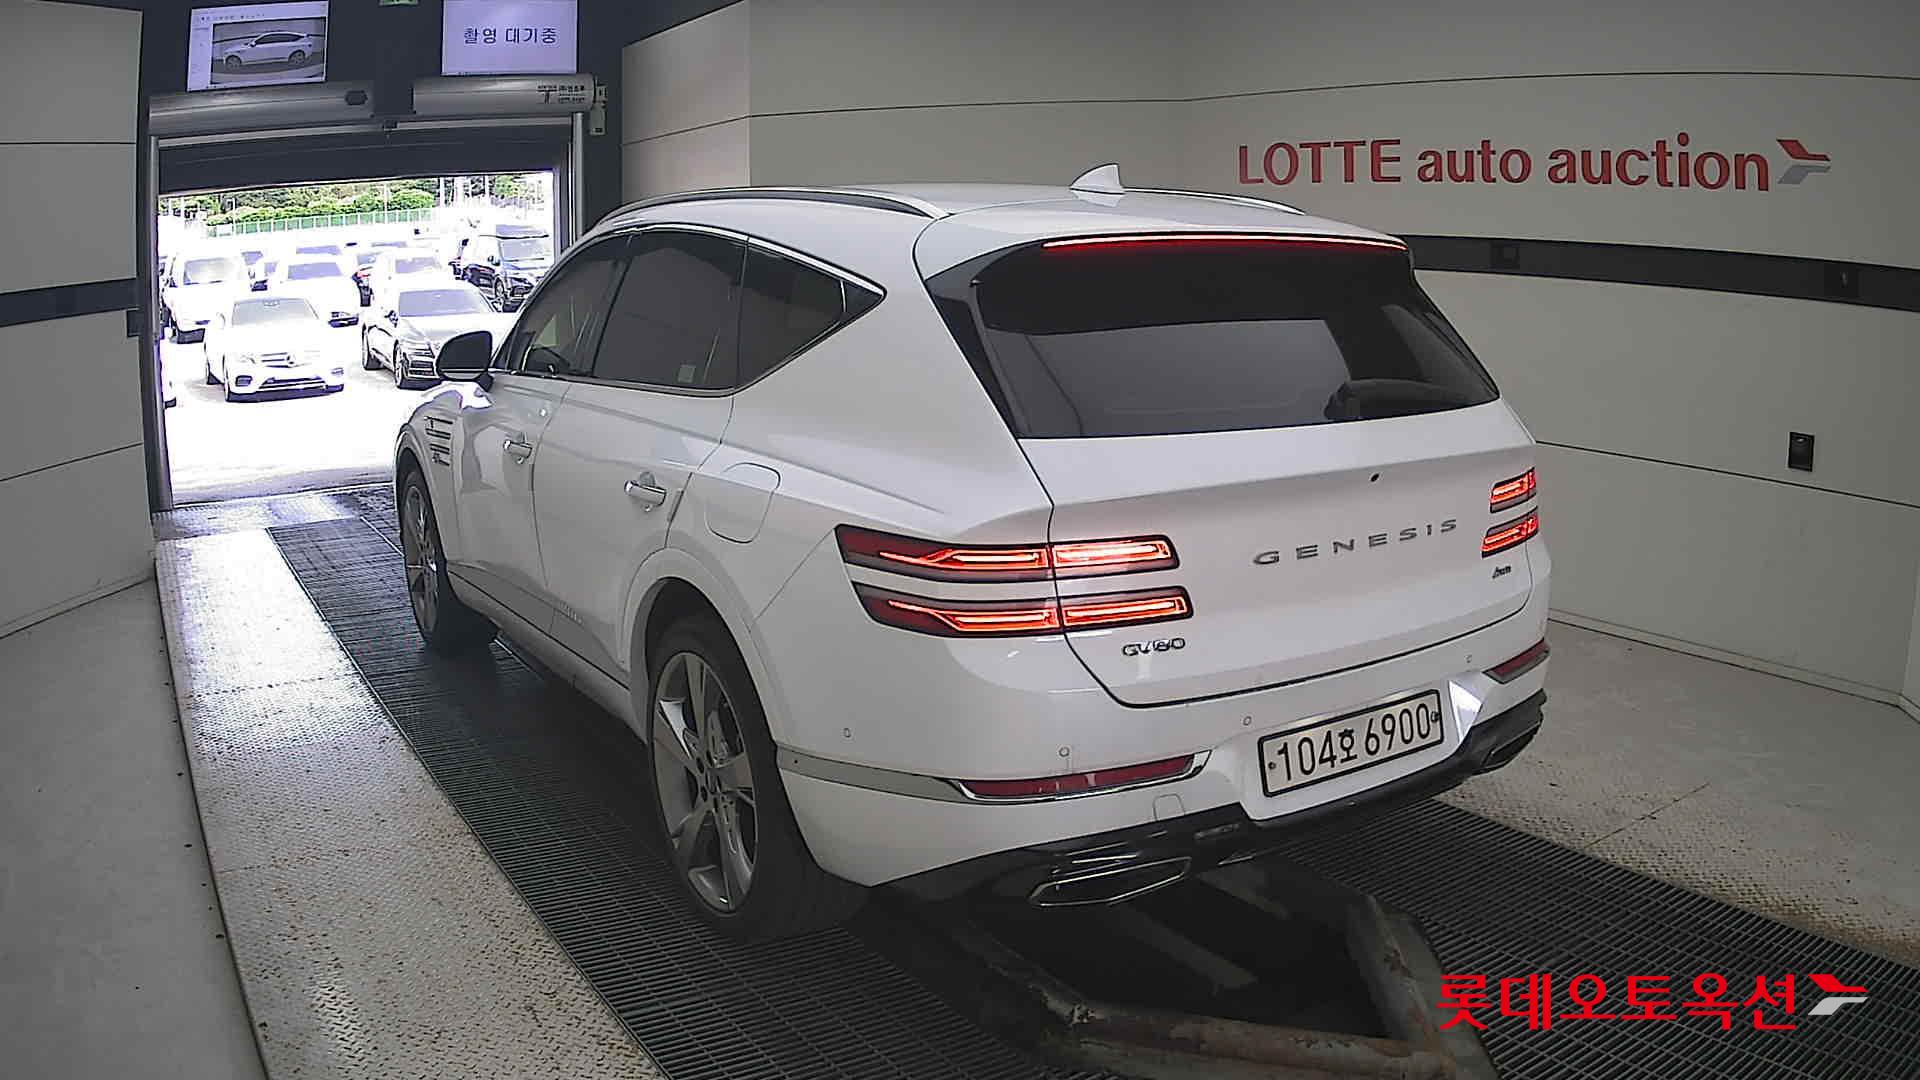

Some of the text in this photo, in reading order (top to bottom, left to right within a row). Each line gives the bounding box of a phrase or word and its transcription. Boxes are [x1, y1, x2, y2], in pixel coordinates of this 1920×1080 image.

[463, 27, 558, 45] 촬영 대기중
[1238, 132, 1769, 192] LOTTE auto auction
[1252, 518, 1458, 566] GENESIS
[1122, 637, 1186, 657] GV80
